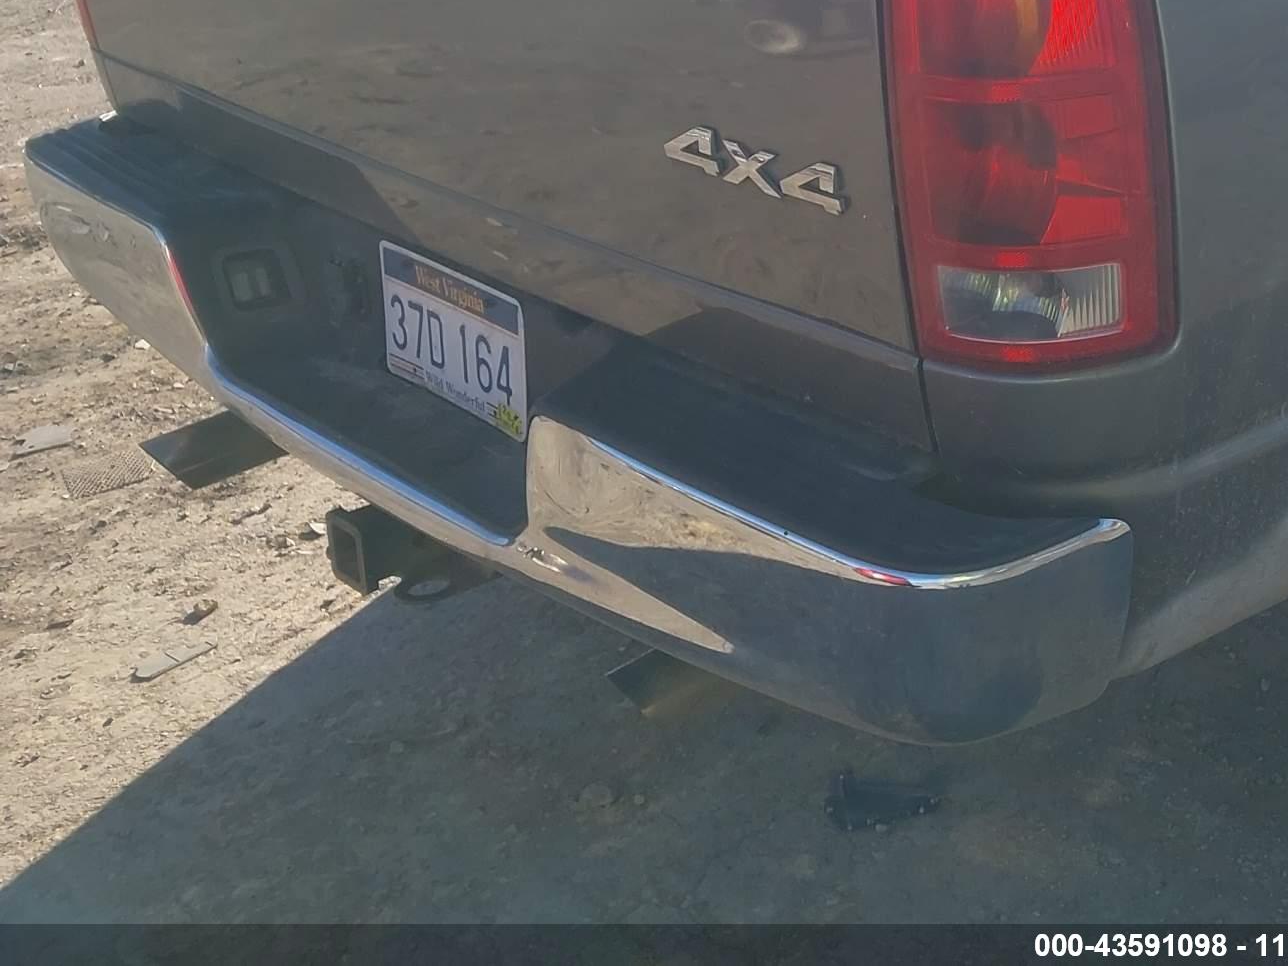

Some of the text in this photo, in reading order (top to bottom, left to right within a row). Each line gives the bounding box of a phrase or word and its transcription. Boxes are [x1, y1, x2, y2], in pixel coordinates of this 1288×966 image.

[415, 264, 485, 315] West Virginia
[390, 294, 513, 406] 37D 164
